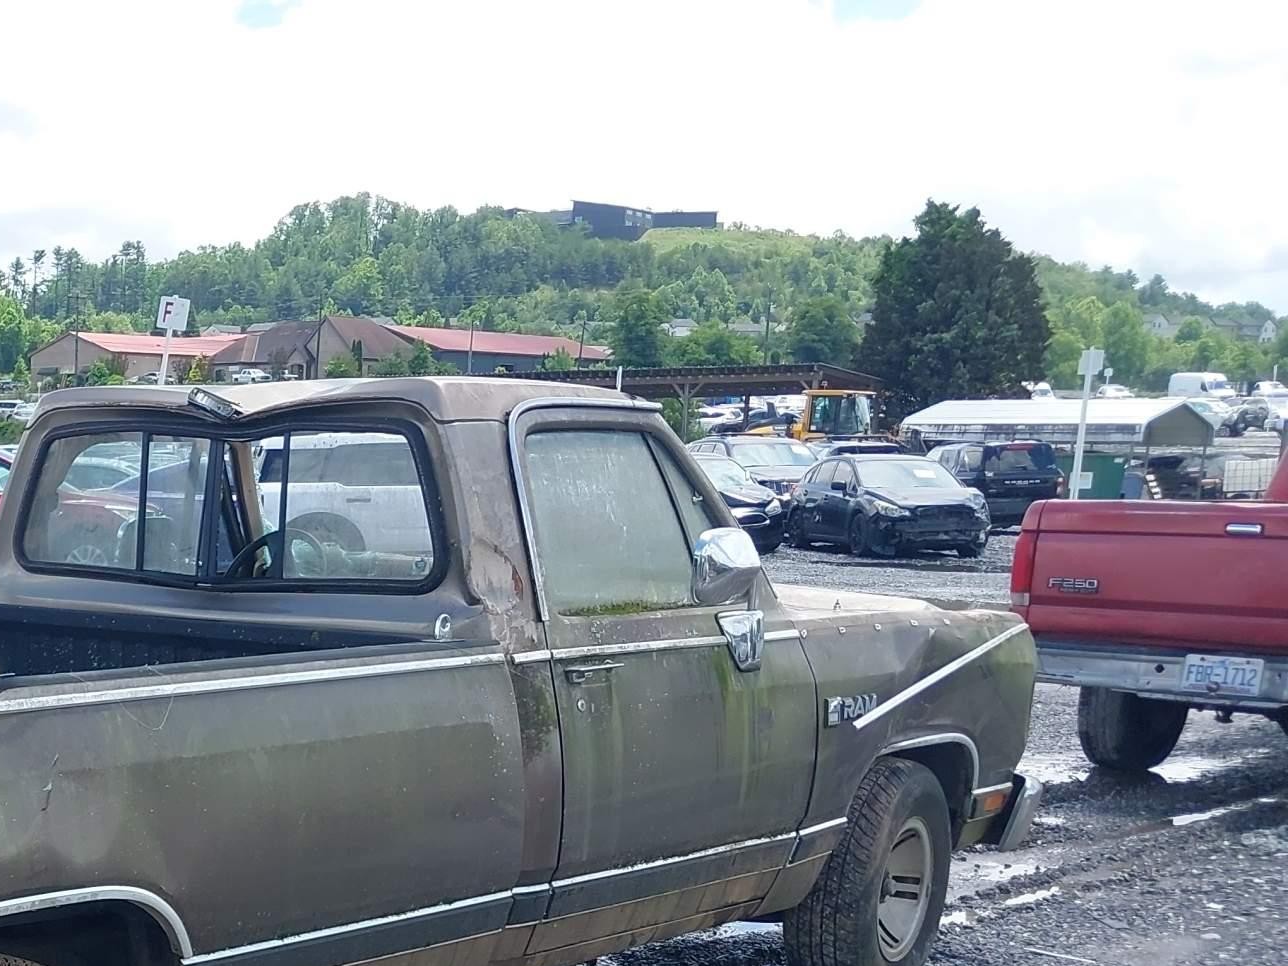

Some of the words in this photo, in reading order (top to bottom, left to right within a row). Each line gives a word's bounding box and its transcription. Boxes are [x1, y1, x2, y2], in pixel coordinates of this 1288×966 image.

[162, 301, 174, 323] F
[1048, 577, 1098, 589] F250
[1186, 663, 1257, 687] FBR-1712
[843, 692, 877, 719] RAM
